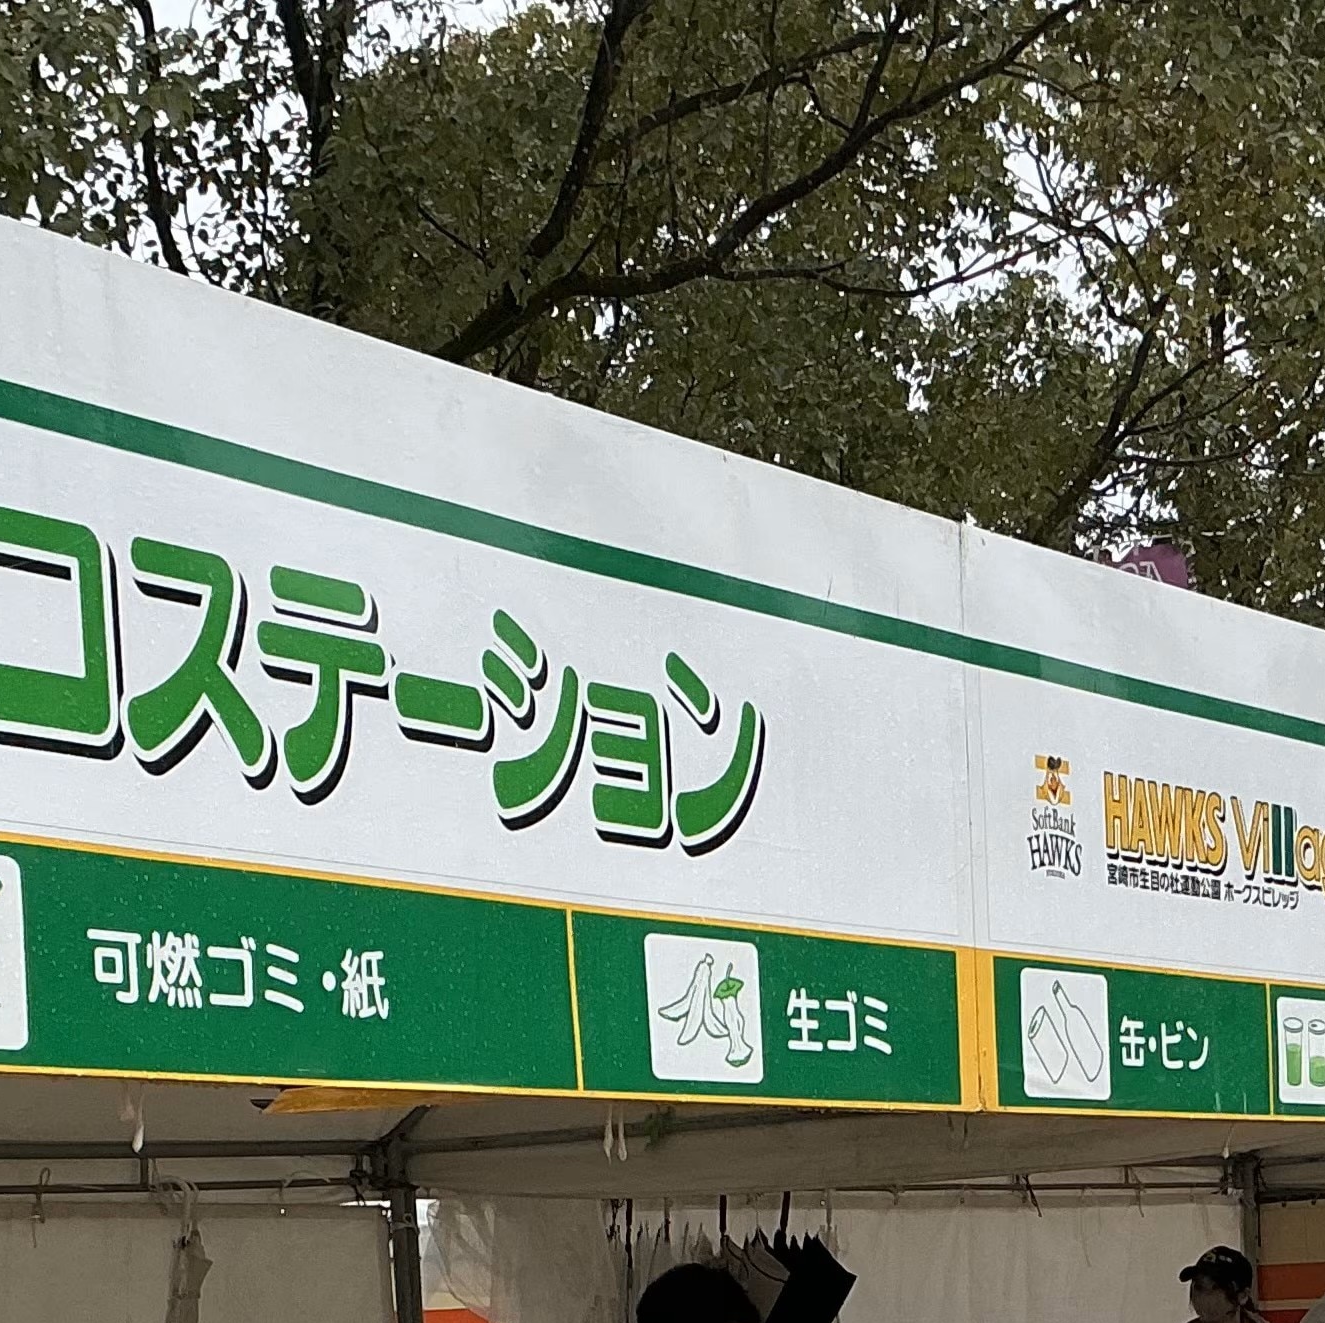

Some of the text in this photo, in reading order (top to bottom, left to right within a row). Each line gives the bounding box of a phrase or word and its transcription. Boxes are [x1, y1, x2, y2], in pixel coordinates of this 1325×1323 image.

[1027, 831, 1082, 877] HAWKS
[1032, 806, 1076, 837] SoftBank
[1103, 771, 1226, 875] HAWKS
[87, 926, 390, 1020] 可燃ゴミ・紙
[786, 987, 893, 1055] 生ゴミ
